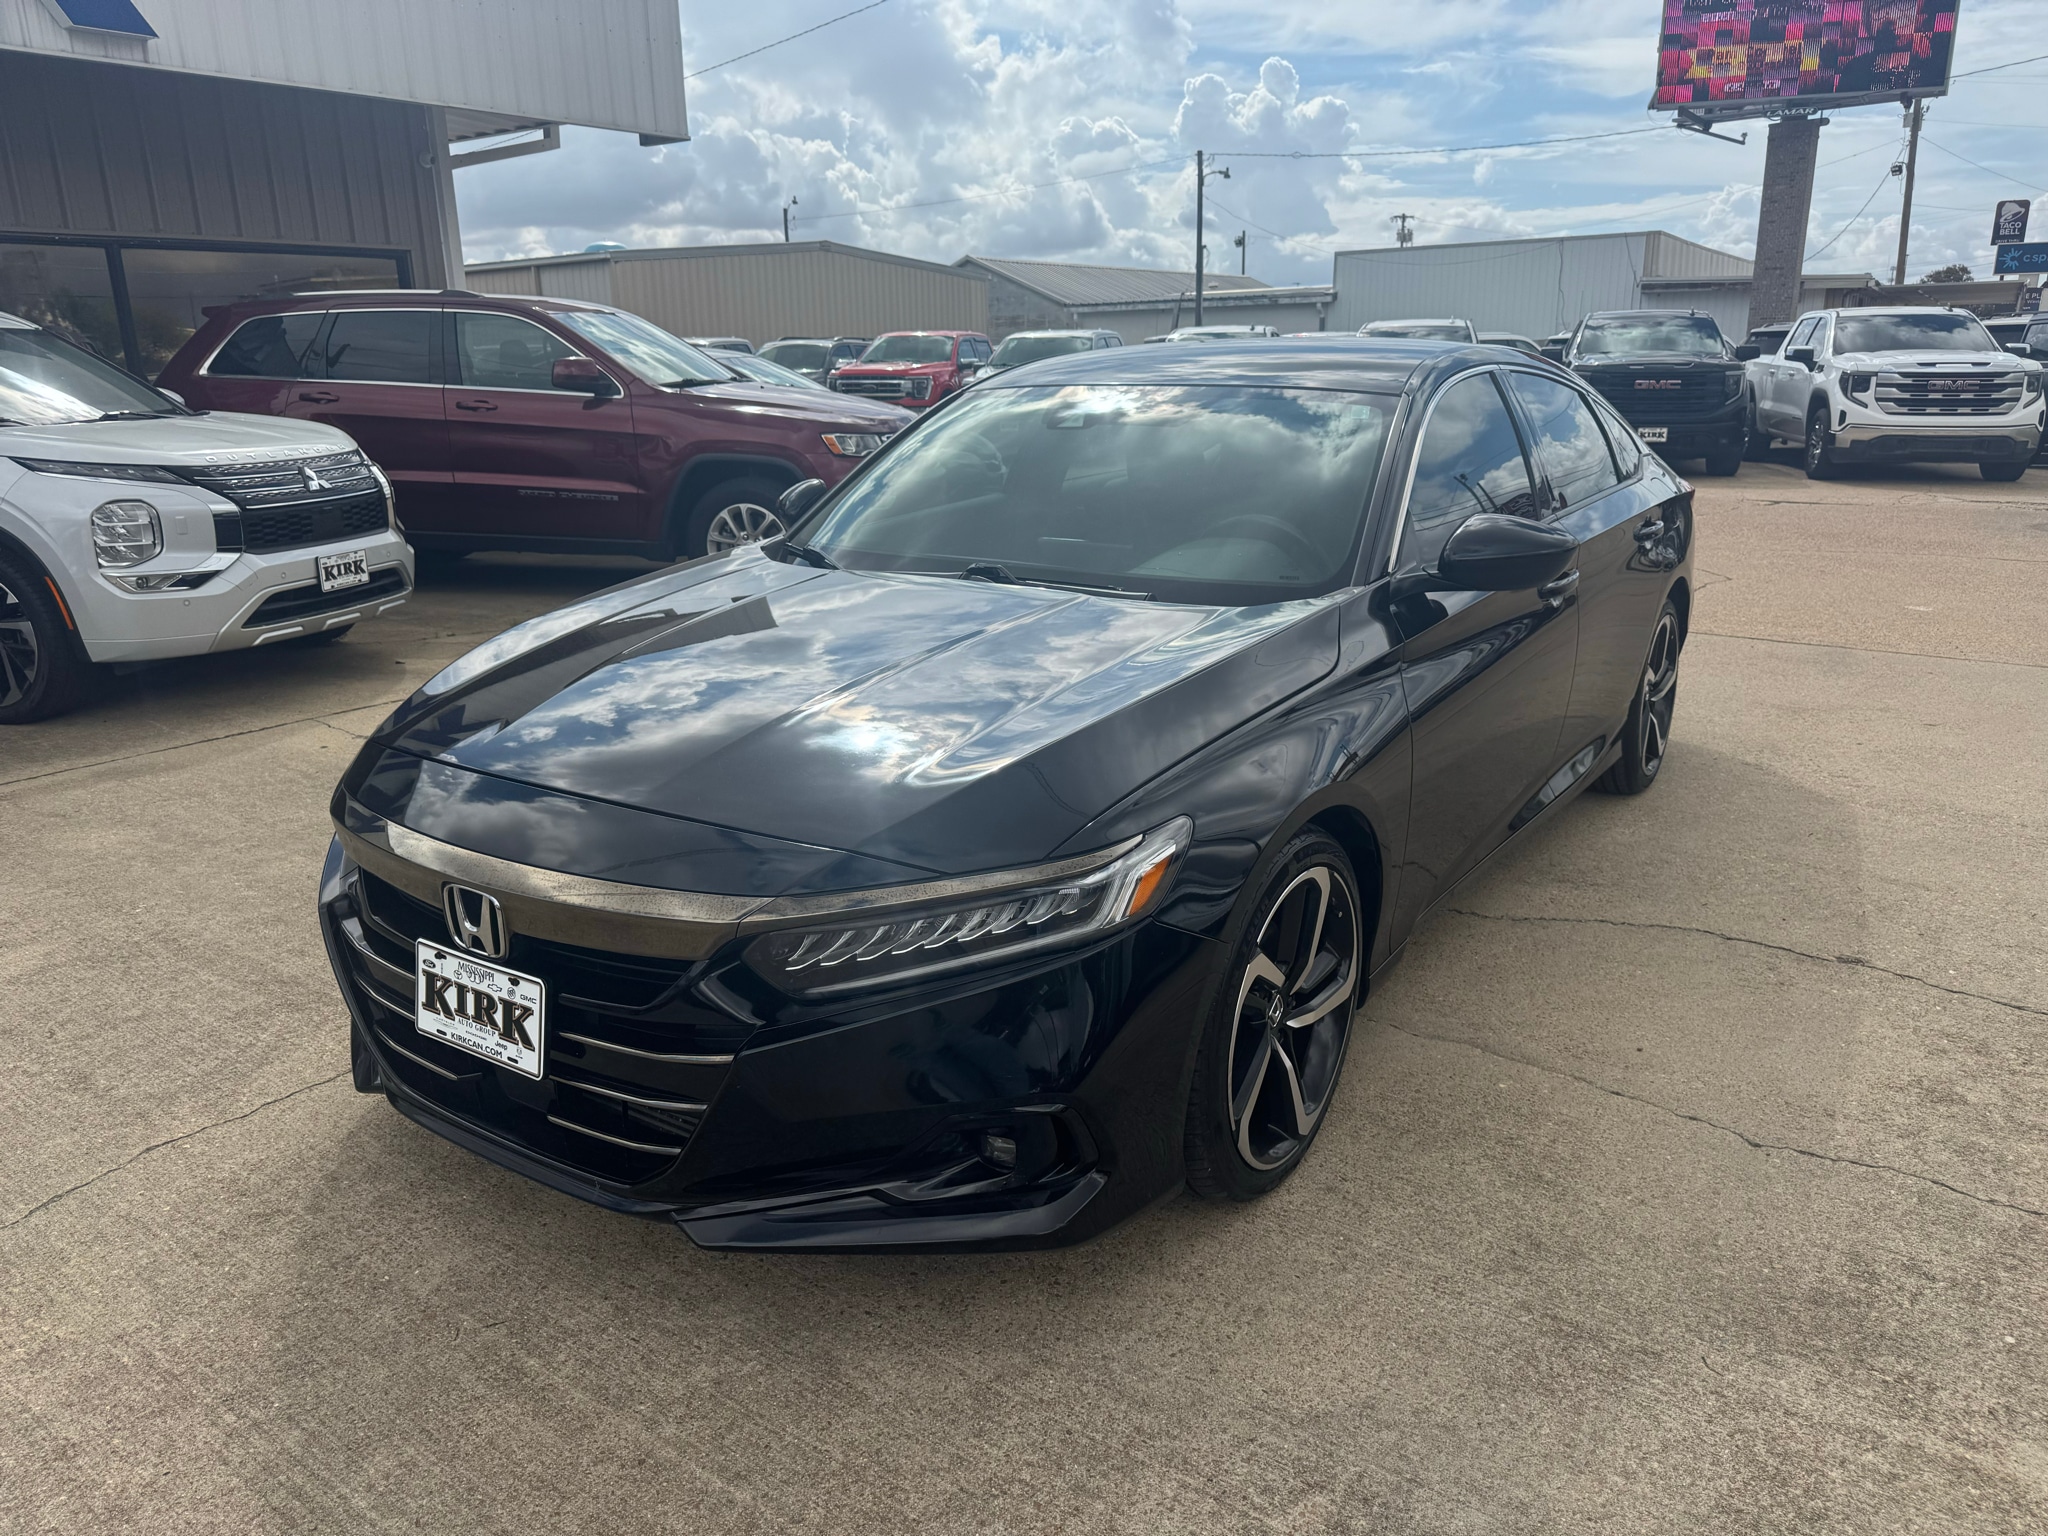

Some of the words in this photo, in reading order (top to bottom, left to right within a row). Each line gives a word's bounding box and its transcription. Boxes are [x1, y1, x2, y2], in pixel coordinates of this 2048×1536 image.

[1766, 108, 1815, 116] LAMAR
[1999, 221, 2022, 229] TACO
[1999, 228, 2020, 236] BELL
[1634, 380, 1681, 389] GMC
[1928, 380, 1980, 390] GMC
[1640, 431, 1665, 439] KIRK
[204, 443, 347, 463] OUTLANDER
[322, 559, 367, 582] KIRK
[423, 959, 436, 969] Ford
[457, 961, 495, 985] MISSISSIPPI
[519, 993, 537, 1005] GMC
[422, 968, 535, 1053] KIRK
[458, 1018, 474, 1029] AUTO
[474, 1024, 496, 1037] GROUP
[450, 1032, 503, 1059] KIRKCAN.COM
[494, 1040, 508, 1051] Jeep
